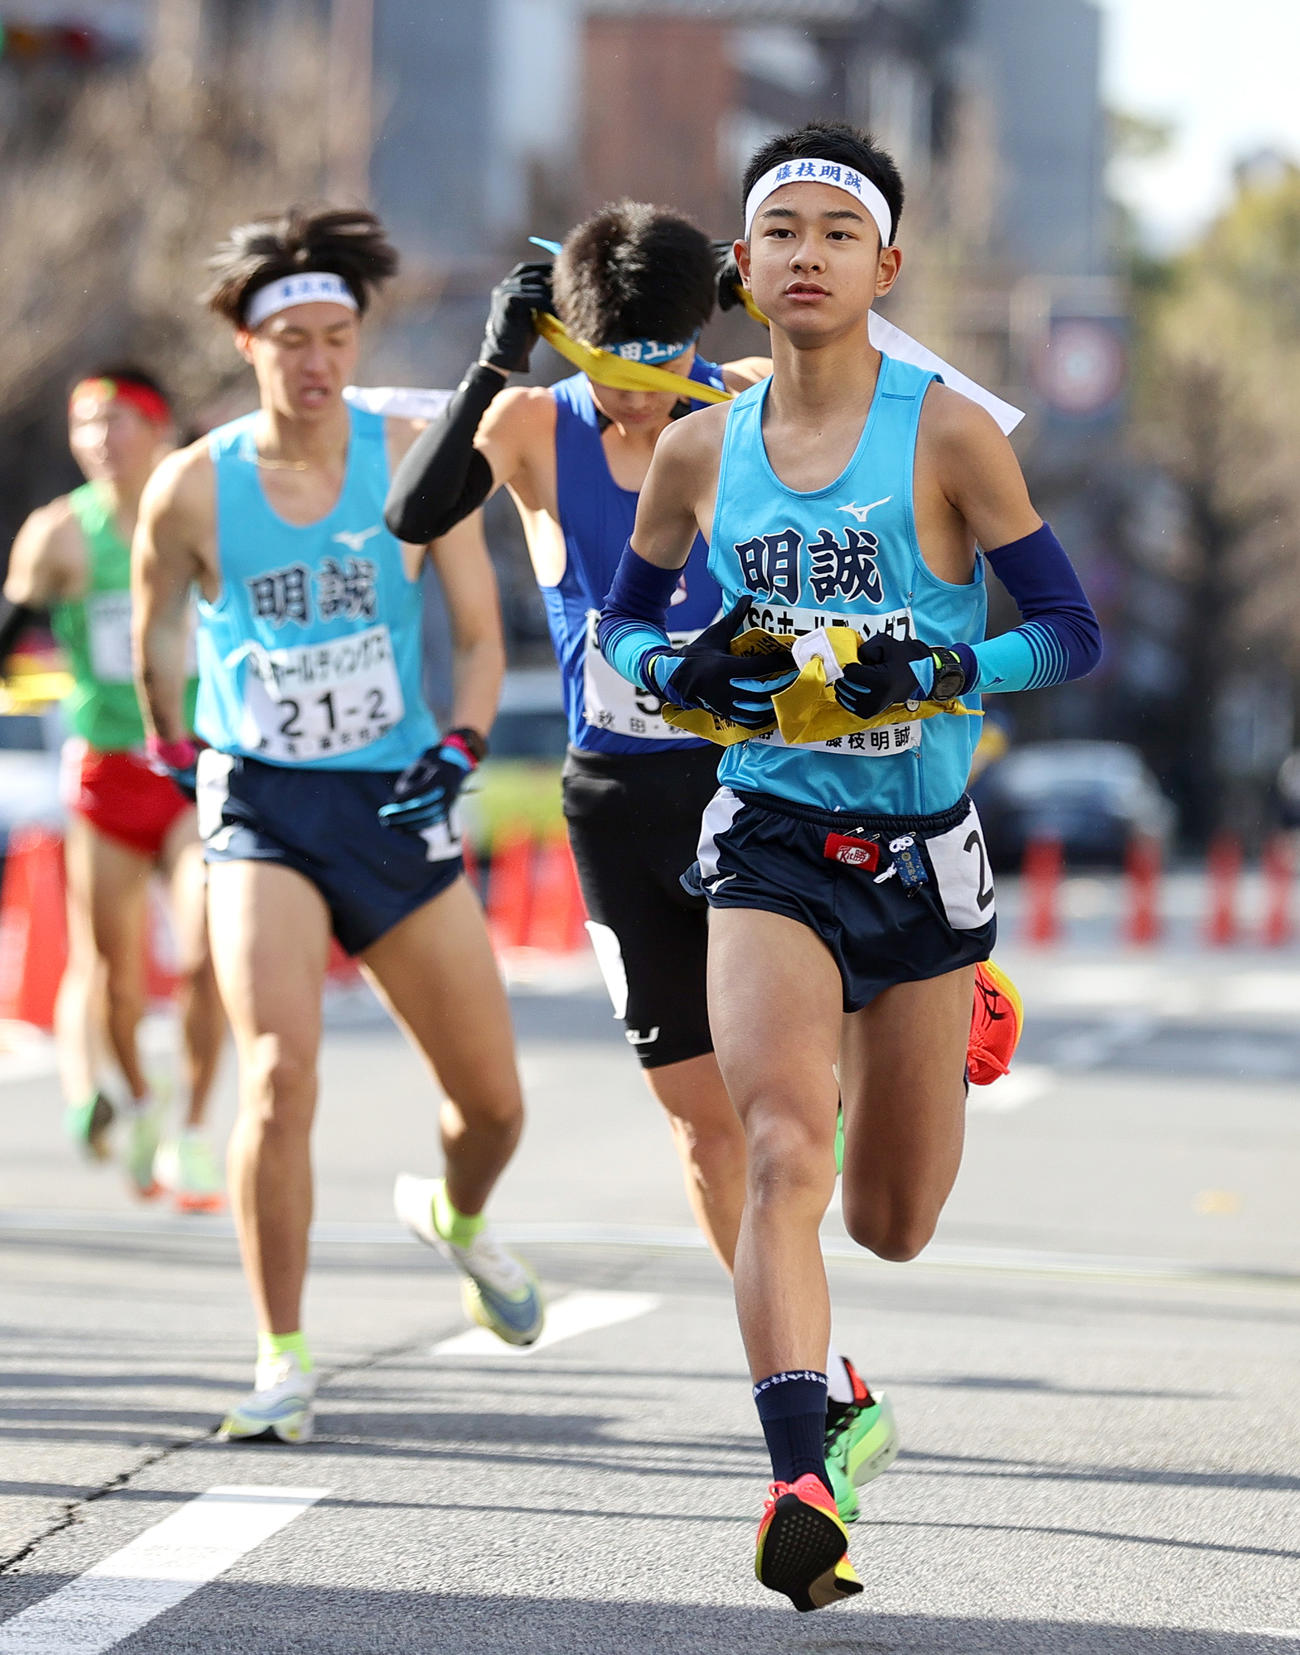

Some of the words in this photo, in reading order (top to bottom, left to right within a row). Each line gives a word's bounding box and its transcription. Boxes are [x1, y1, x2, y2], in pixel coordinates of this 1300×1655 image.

[601, 340, 684, 361] 田工
[246, 557, 378, 629] 明誠
[733, 526, 885, 605] 明誠
[748, 607, 910, 642] SGホーングス
[277, 689, 387, 738] 21-2
[963, 829, 995, 912] 2
